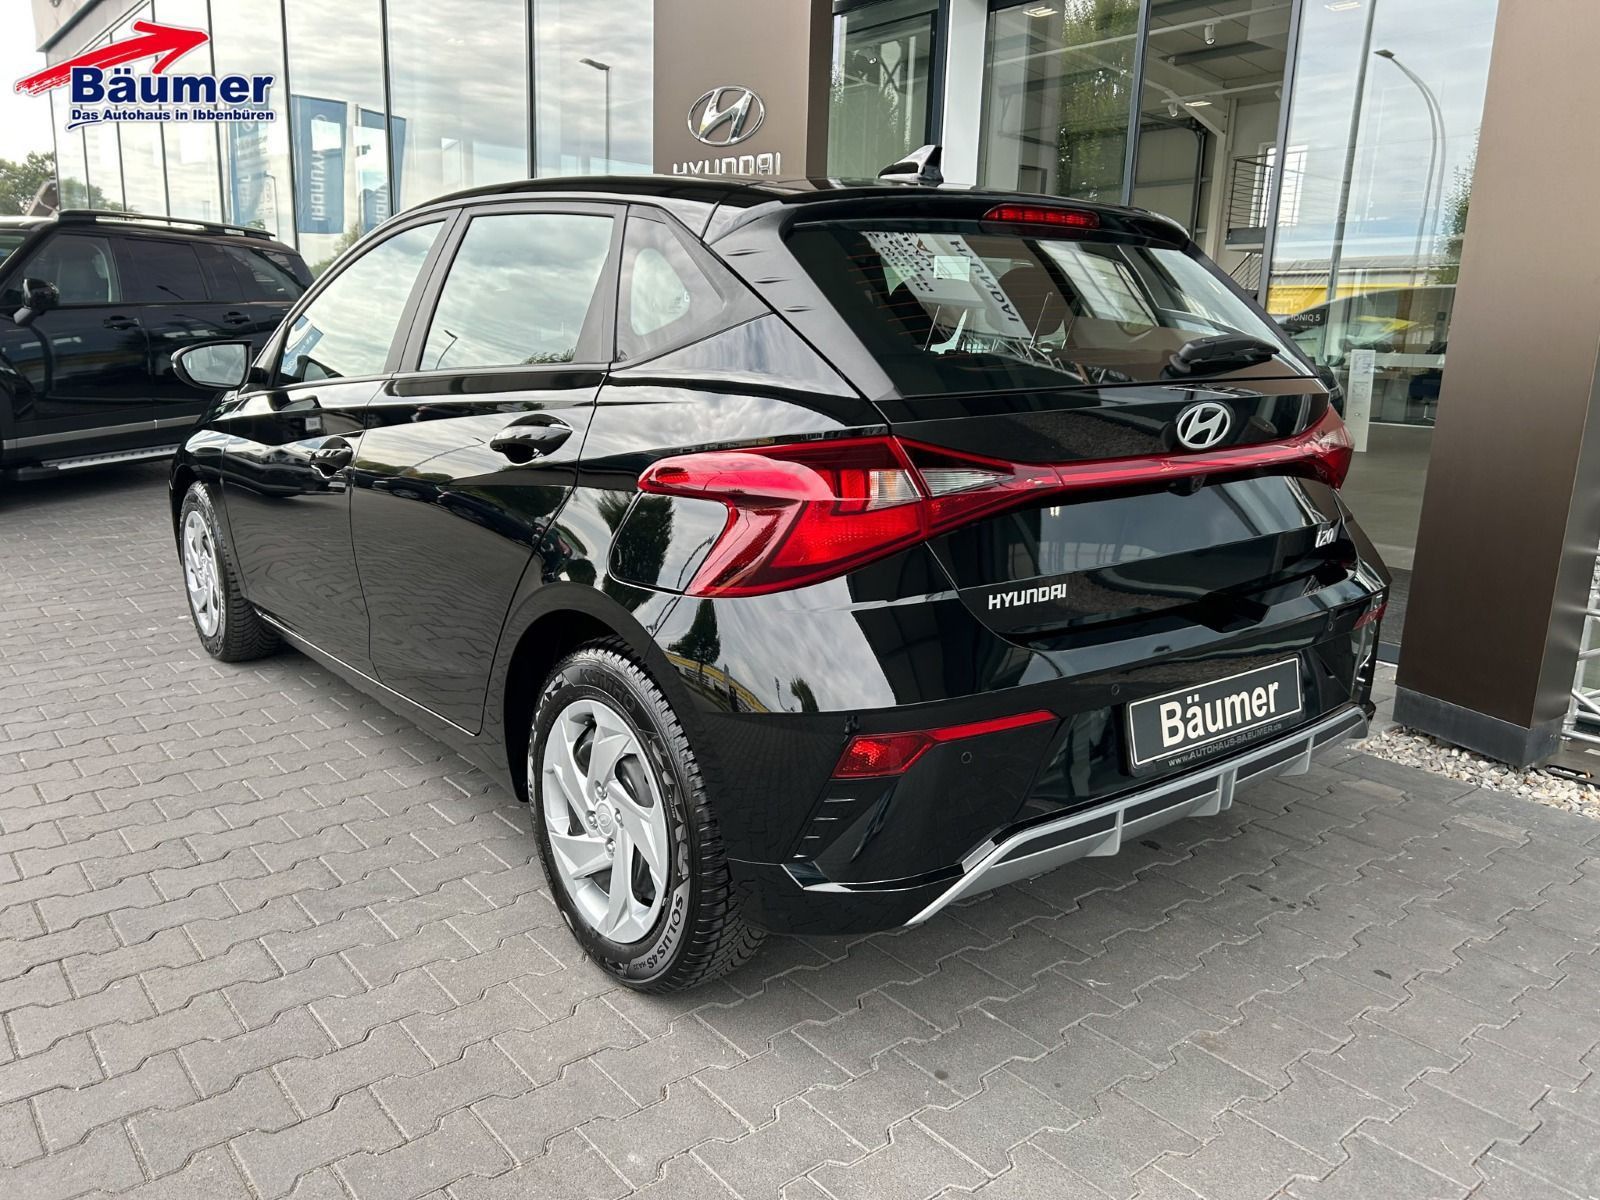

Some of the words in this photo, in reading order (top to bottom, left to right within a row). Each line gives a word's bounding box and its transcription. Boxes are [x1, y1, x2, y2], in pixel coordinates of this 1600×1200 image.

[1315, 313, 1321, 322] 5
[988, 583, 1067, 610] HYUNDAI
[1159, 681, 1279, 748] Bäumer
